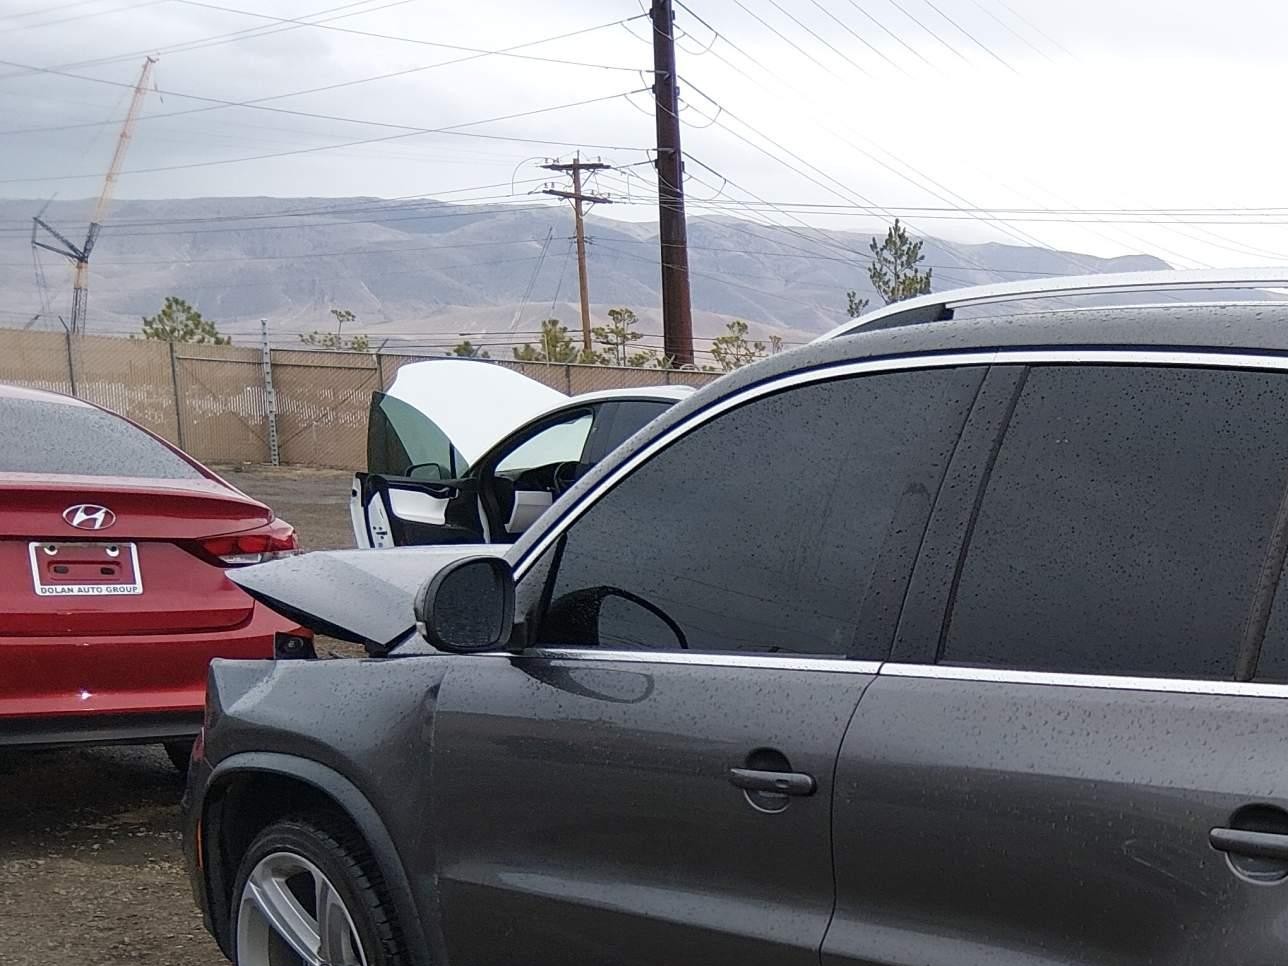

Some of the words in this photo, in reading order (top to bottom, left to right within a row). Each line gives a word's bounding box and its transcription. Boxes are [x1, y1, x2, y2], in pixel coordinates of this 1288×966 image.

[40, 586, 74, 594] DOLAN
[77, 586, 103, 594] AUTO
[105, 585, 138, 593] GROUP
